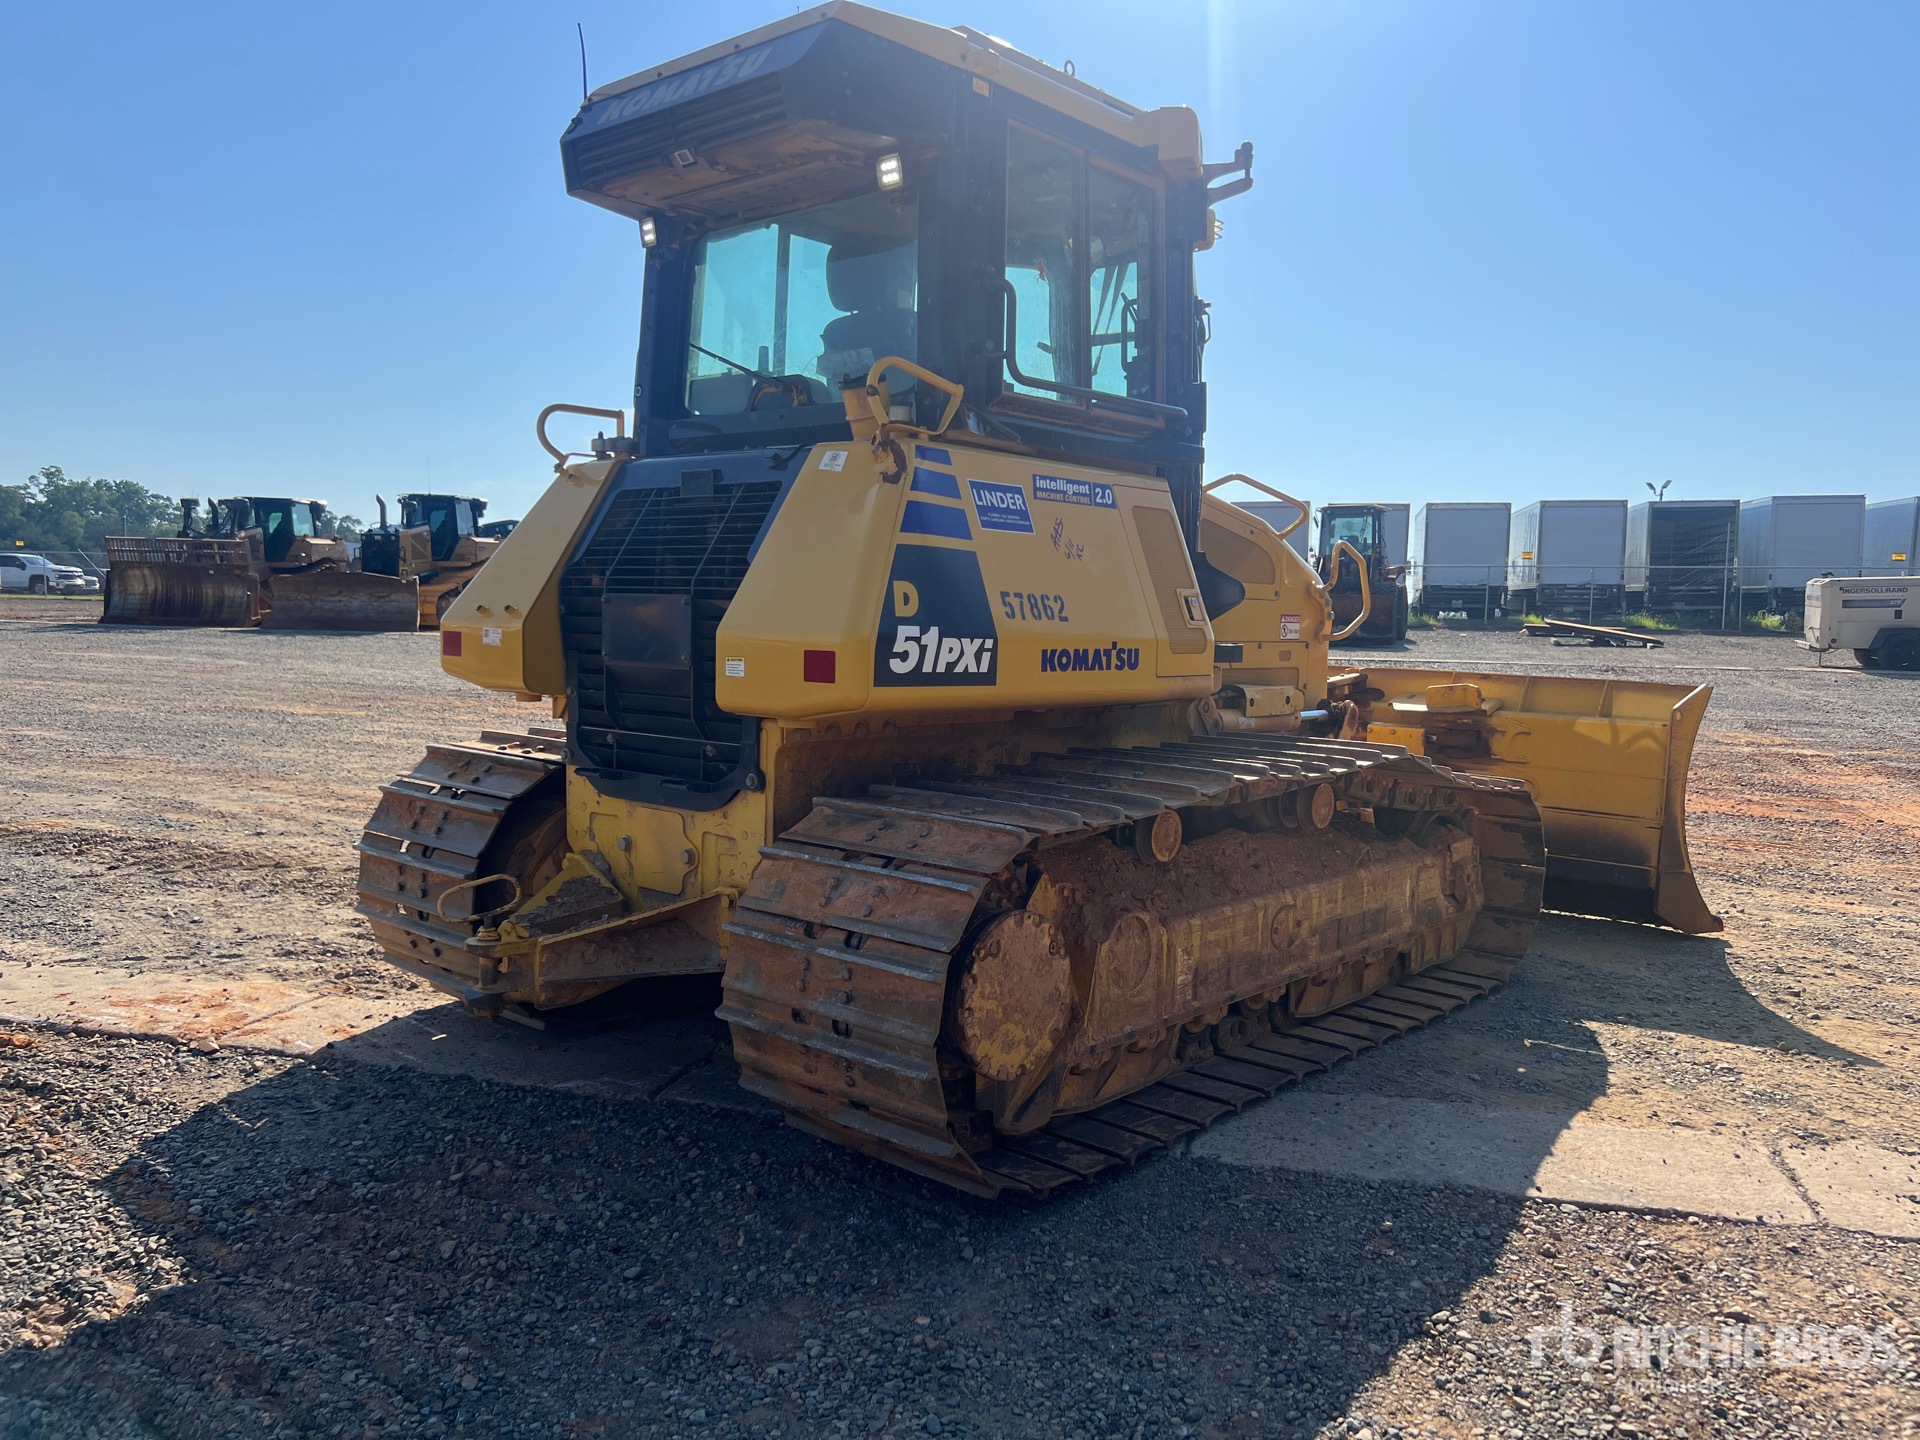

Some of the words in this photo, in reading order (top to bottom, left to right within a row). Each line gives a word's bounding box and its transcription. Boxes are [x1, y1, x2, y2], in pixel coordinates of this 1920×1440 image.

[597, 47, 773, 125] KOMATSU
[1036, 476, 1090, 495] intelligent
[1036, 490, 1064, 501] MACHINE
[1065, 494, 1091, 505] CONTROL
[1095, 487, 1113, 505] 2.0
[972, 488, 1026, 511] LINDER
[893, 580, 919, 617] D
[999, 590, 1070, 622] 57862
[1040, 641, 1140, 672] KOMATSU
